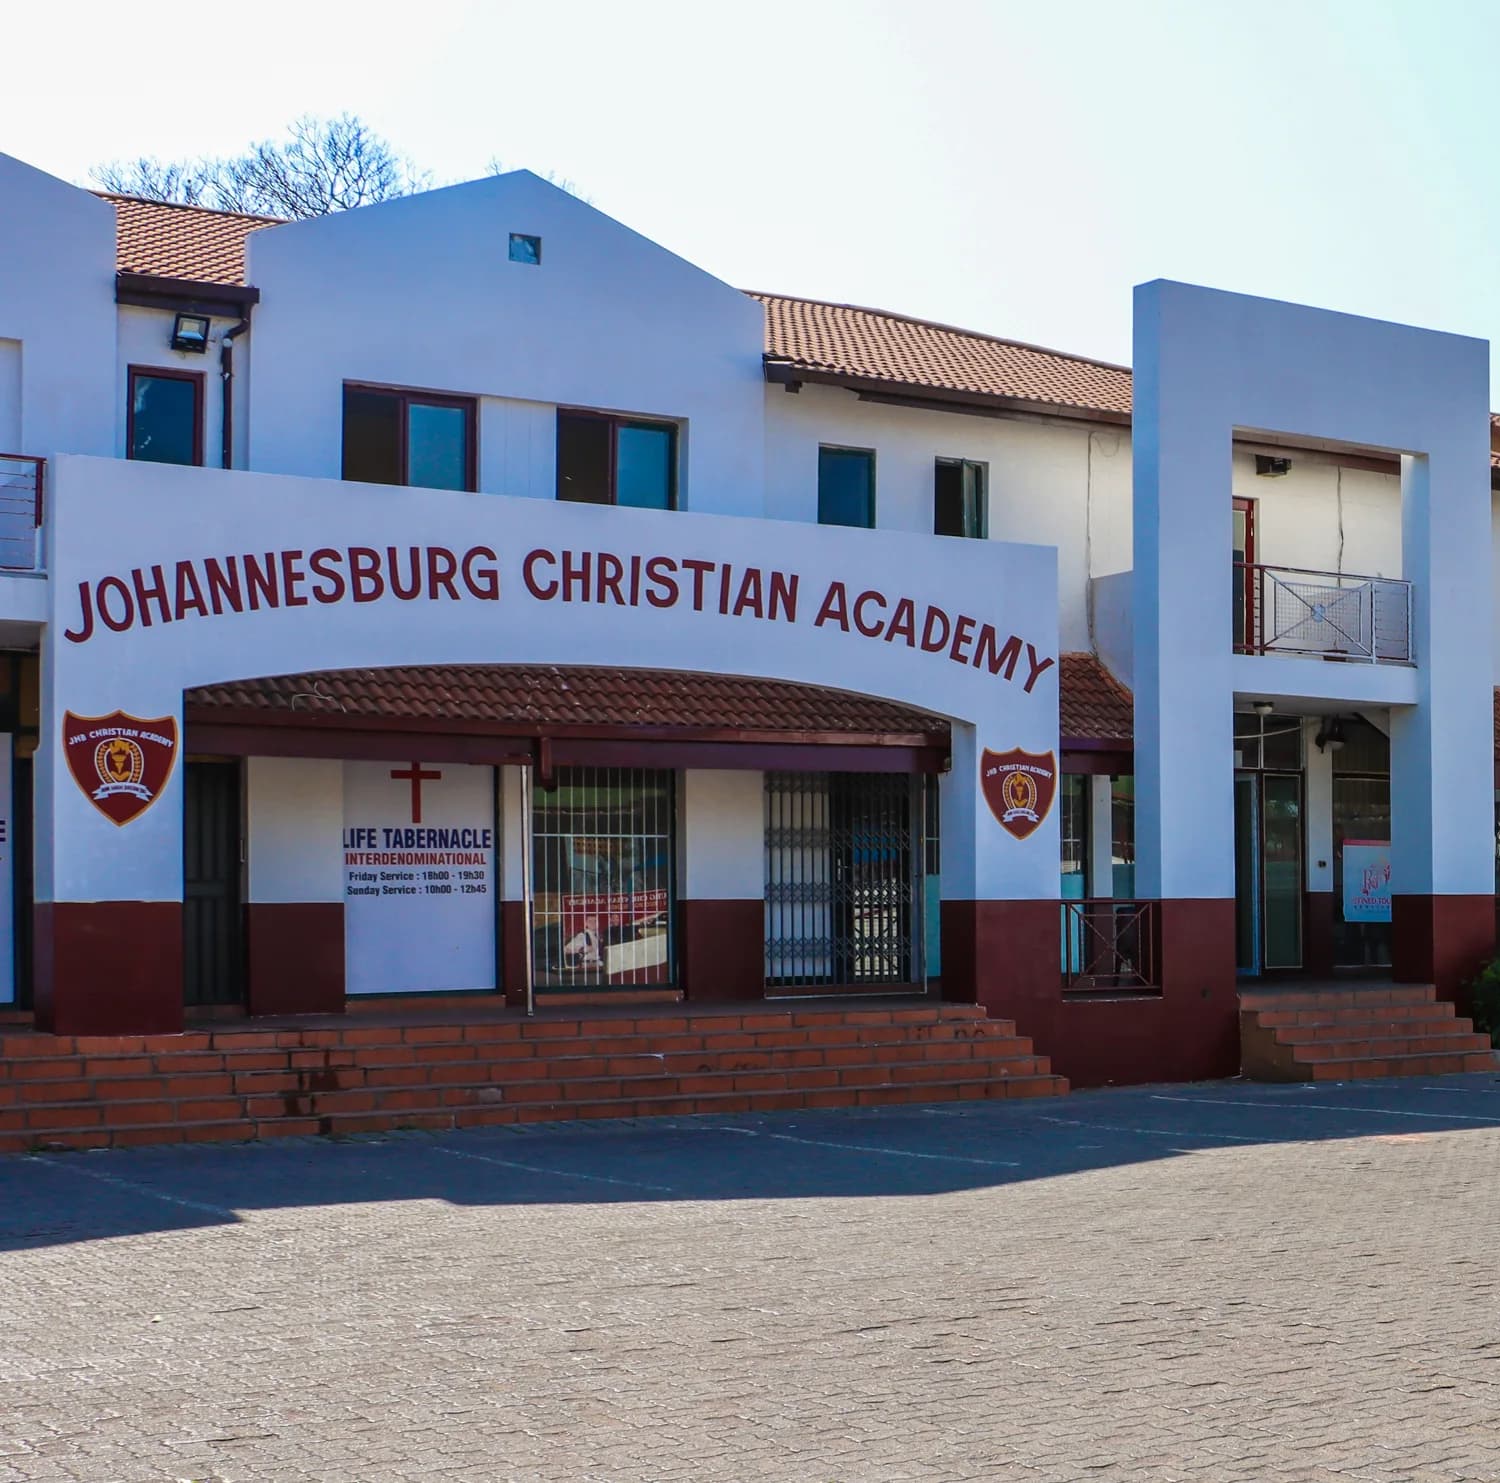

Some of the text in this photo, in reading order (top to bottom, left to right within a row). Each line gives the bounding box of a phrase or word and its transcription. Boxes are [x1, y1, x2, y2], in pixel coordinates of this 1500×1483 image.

[64, 546, 1055, 694] JOHANNESBURG CHRISTIAN ACADEMY
[69, 728, 174, 748] JHB CHRISTIAN ACADEMY
[343, 828, 491, 849] LIFE TABERNACLE
[345, 852, 487, 866] INTERDENOMINATIONAL
[349, 871, 377, 882] Friday
[380, 871, 414, 881] Service
[458, 870, 484, 880] 19h30
[347, 885, 379, 896] Sunday
[382, 885, 416, 895] Service
[425, 884, 451, 894] 10h00
[460, 884, 487, 894] 12h45
